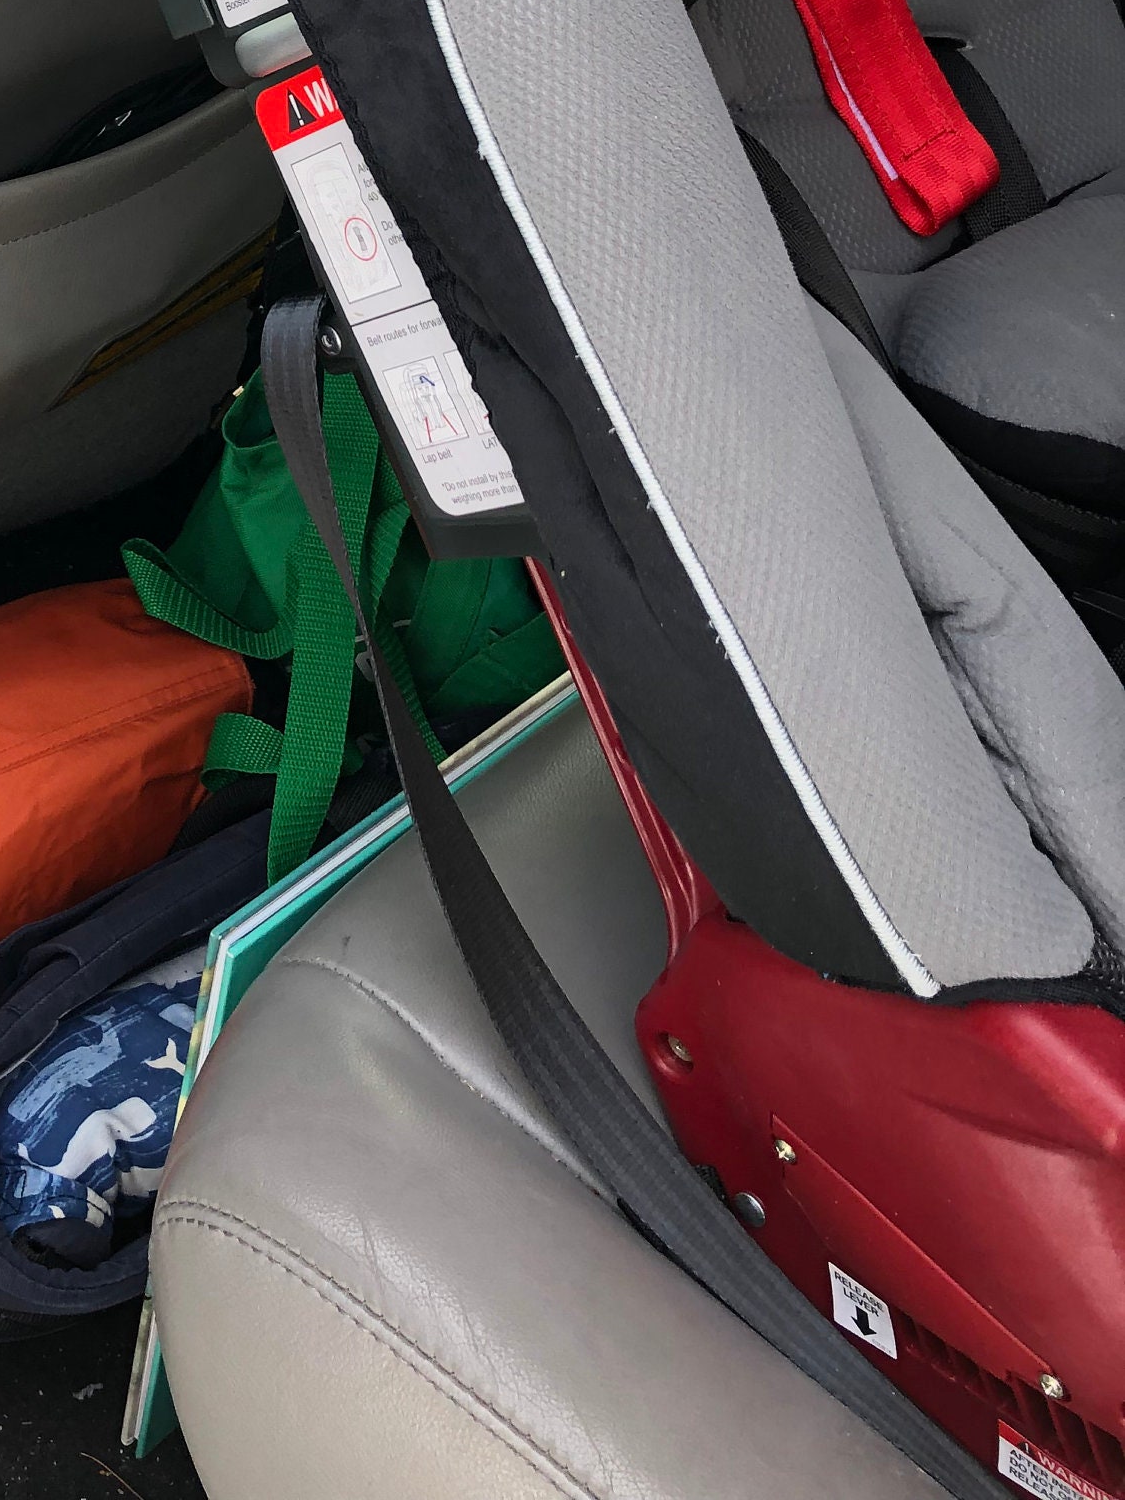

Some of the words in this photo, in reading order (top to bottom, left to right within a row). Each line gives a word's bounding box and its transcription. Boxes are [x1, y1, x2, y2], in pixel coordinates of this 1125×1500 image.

[381, 220, 393, 231] Do
[366, 334, 383, 347] Belt
[383, 328, 407, 341] routes
[407, 323, 419, 334] for
[421, 453, 437, 464] Lap
[437, 448, 453, 459] belt
[456, 480, 468, 490] not
[468, 474, 488, 486] install
[488, 472, 499, 483] by
[499, 470, 513, 480] this
[451, 491, 482, 505] weighing
[482, 487, 501, 498] more
[501, 484, 517, 494] than
[834, 1270, 885, 1313] RELEASE
[842, 1286, 879, 1317] LEVER
[1009, 1457, 1027, 1473] DO
[1030, 1471, 1054, 1492] NOT
[1010, 1449, 1049, 1478] AFTER
